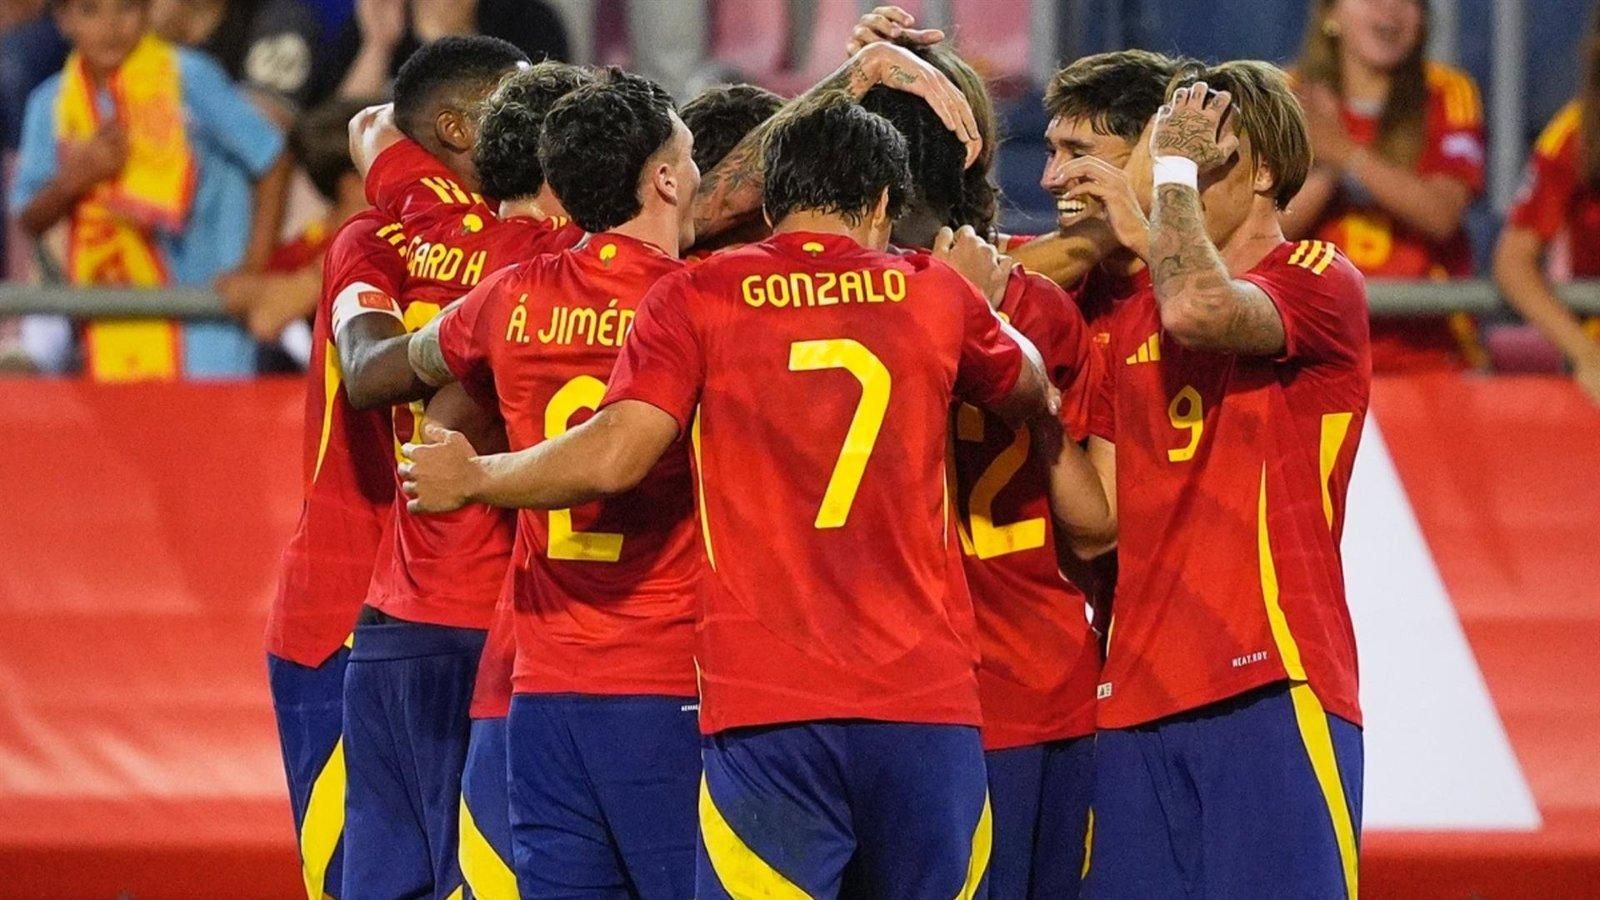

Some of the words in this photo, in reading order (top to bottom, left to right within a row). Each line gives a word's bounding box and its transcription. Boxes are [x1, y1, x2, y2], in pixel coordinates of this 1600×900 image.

[461, 250, 487, 286] H
[742, 269, 906, 308] GONZALO
[506, 293, 530, 343] Á.
[788, 338, 892, 529] 7
[1168, 384, 1204, 462] 9
